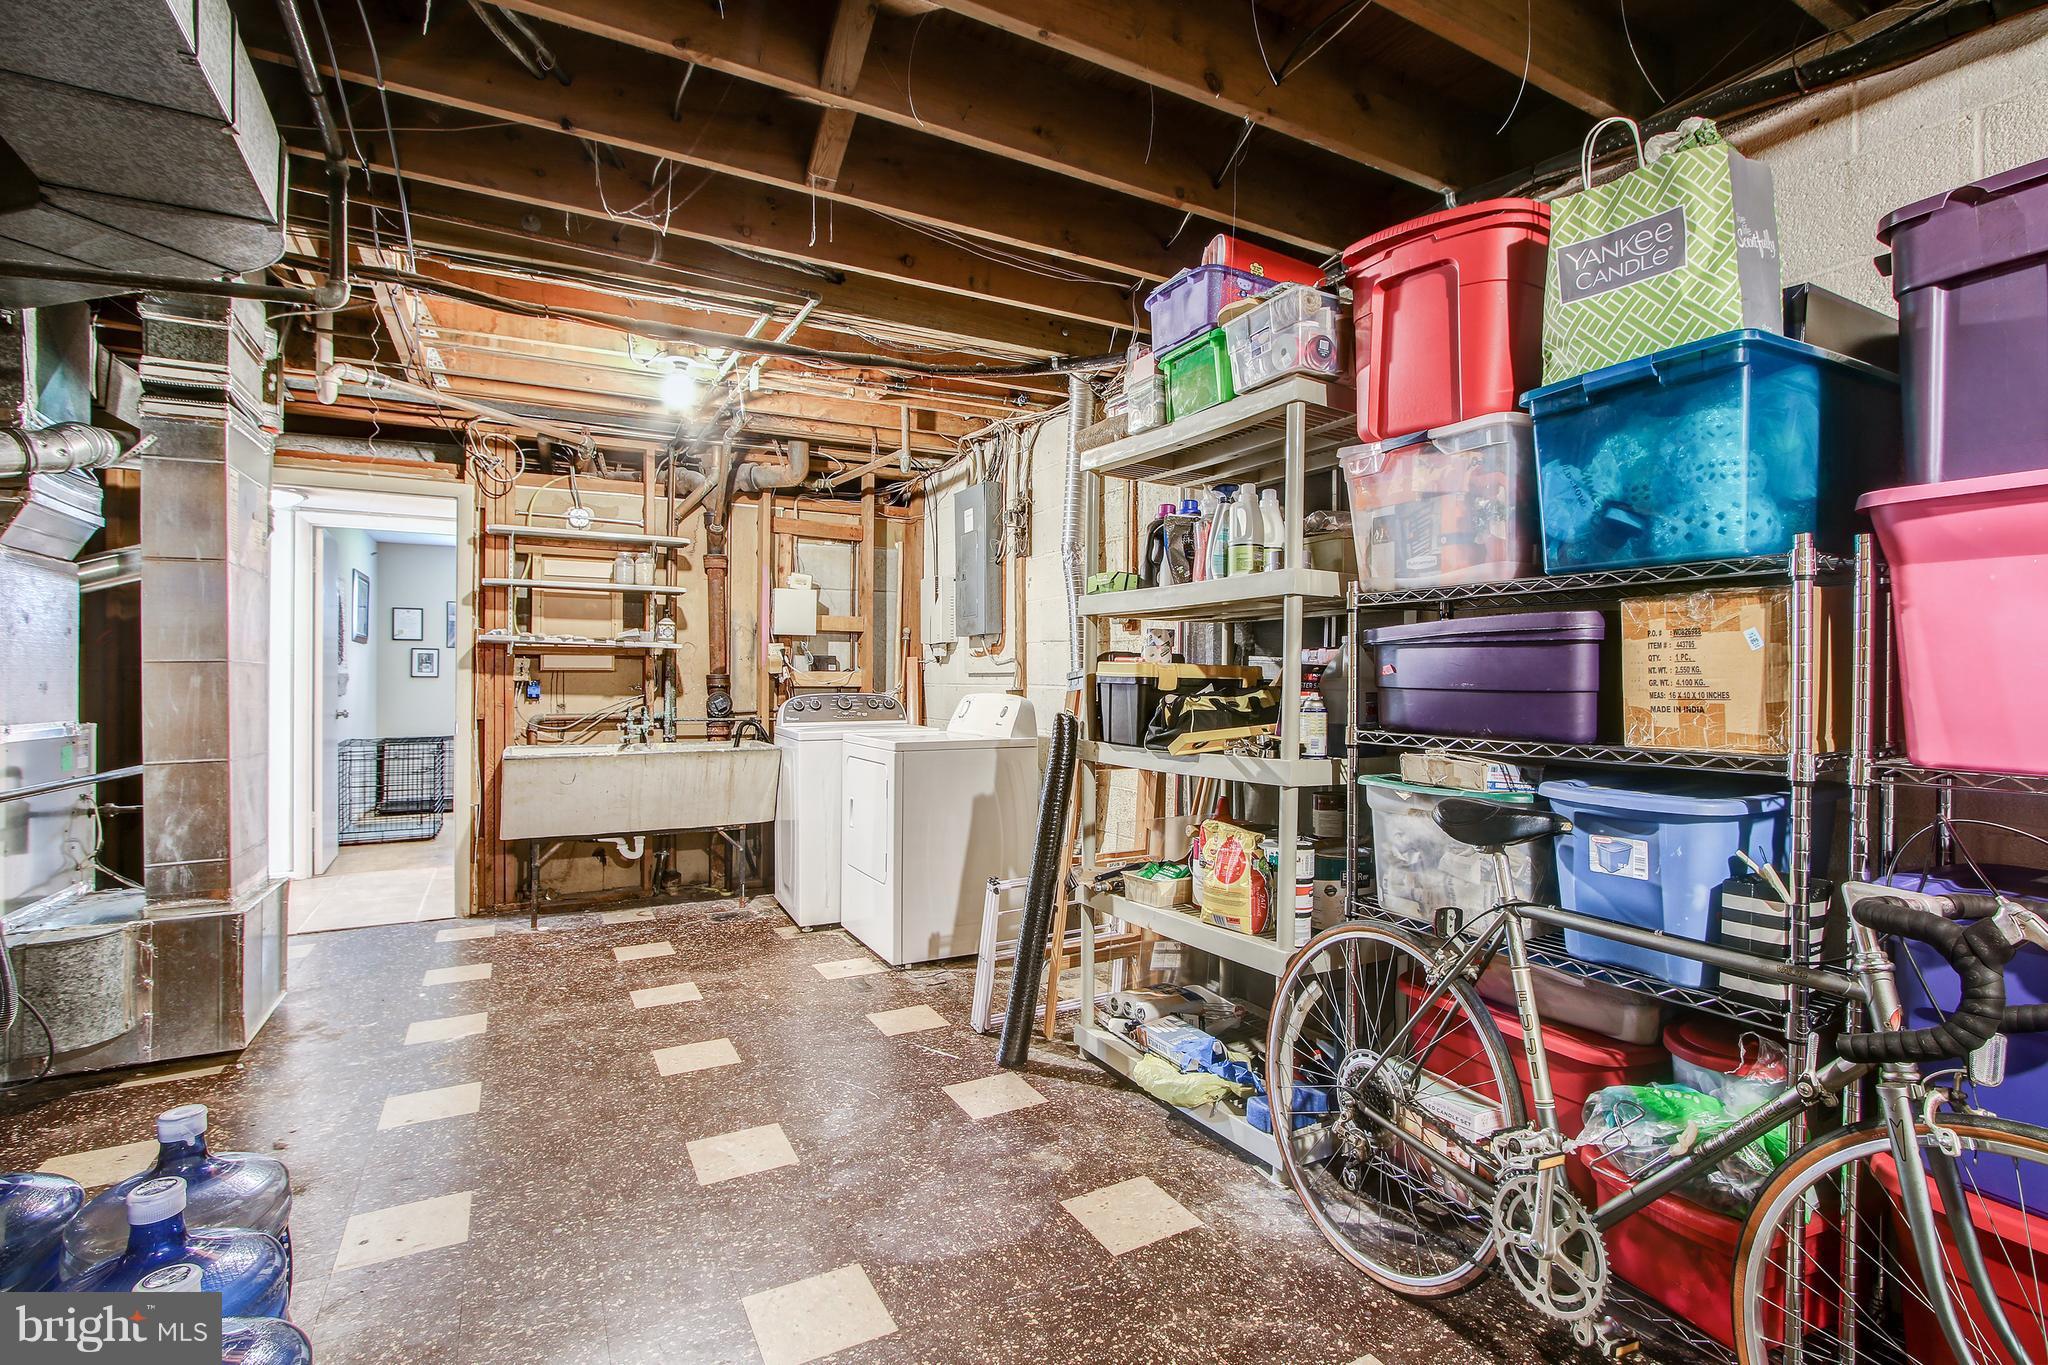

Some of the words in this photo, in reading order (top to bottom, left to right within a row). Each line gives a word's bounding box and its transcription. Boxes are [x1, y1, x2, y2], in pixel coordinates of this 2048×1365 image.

[1648, 642, 1662, 650] ITEM
[1706, 691, 1730, 699] INCHES
[1516, 990, 1539, 1079] FUJI
[1437, 1108, 1461, 1121] CANDLE
[1461, 1118, 1472, 1127] SET
